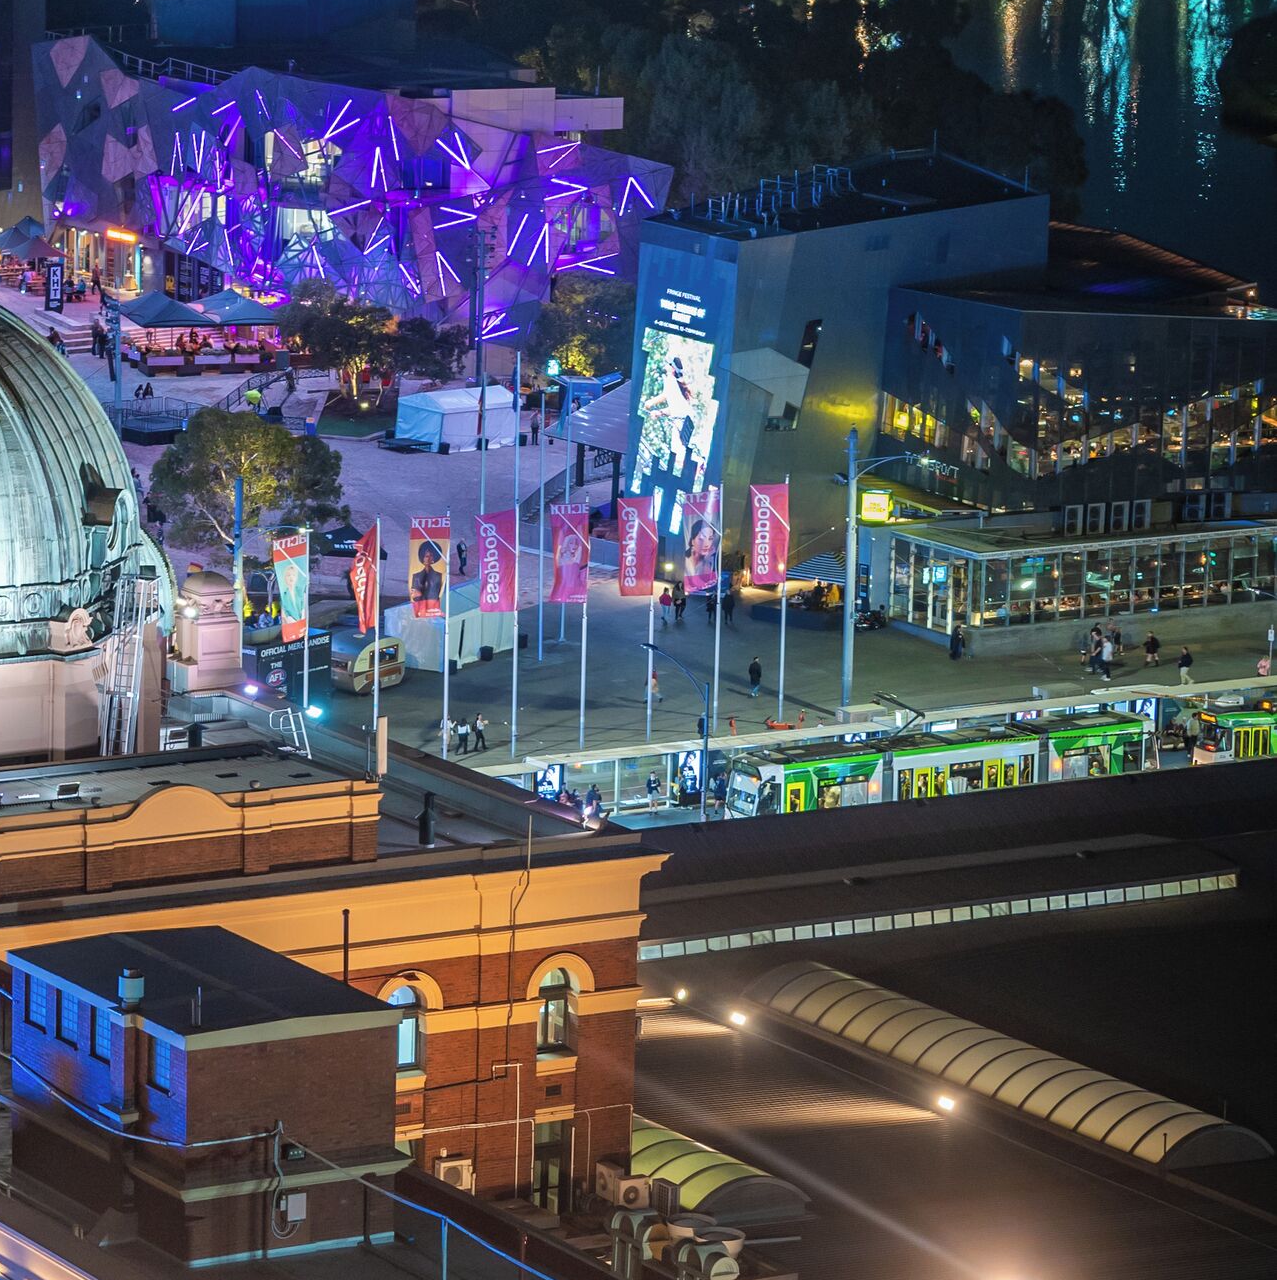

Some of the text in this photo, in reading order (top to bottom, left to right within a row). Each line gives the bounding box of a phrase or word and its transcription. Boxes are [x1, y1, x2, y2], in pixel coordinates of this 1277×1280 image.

[51, 268, 61, 298] KHT
[260, 644, 287, 658] OFFICIAL
[287, 635, 330, 652] MERCANDISE
[270, 661, 283, 669] THE
[269, 672, 285, 682] AFL
